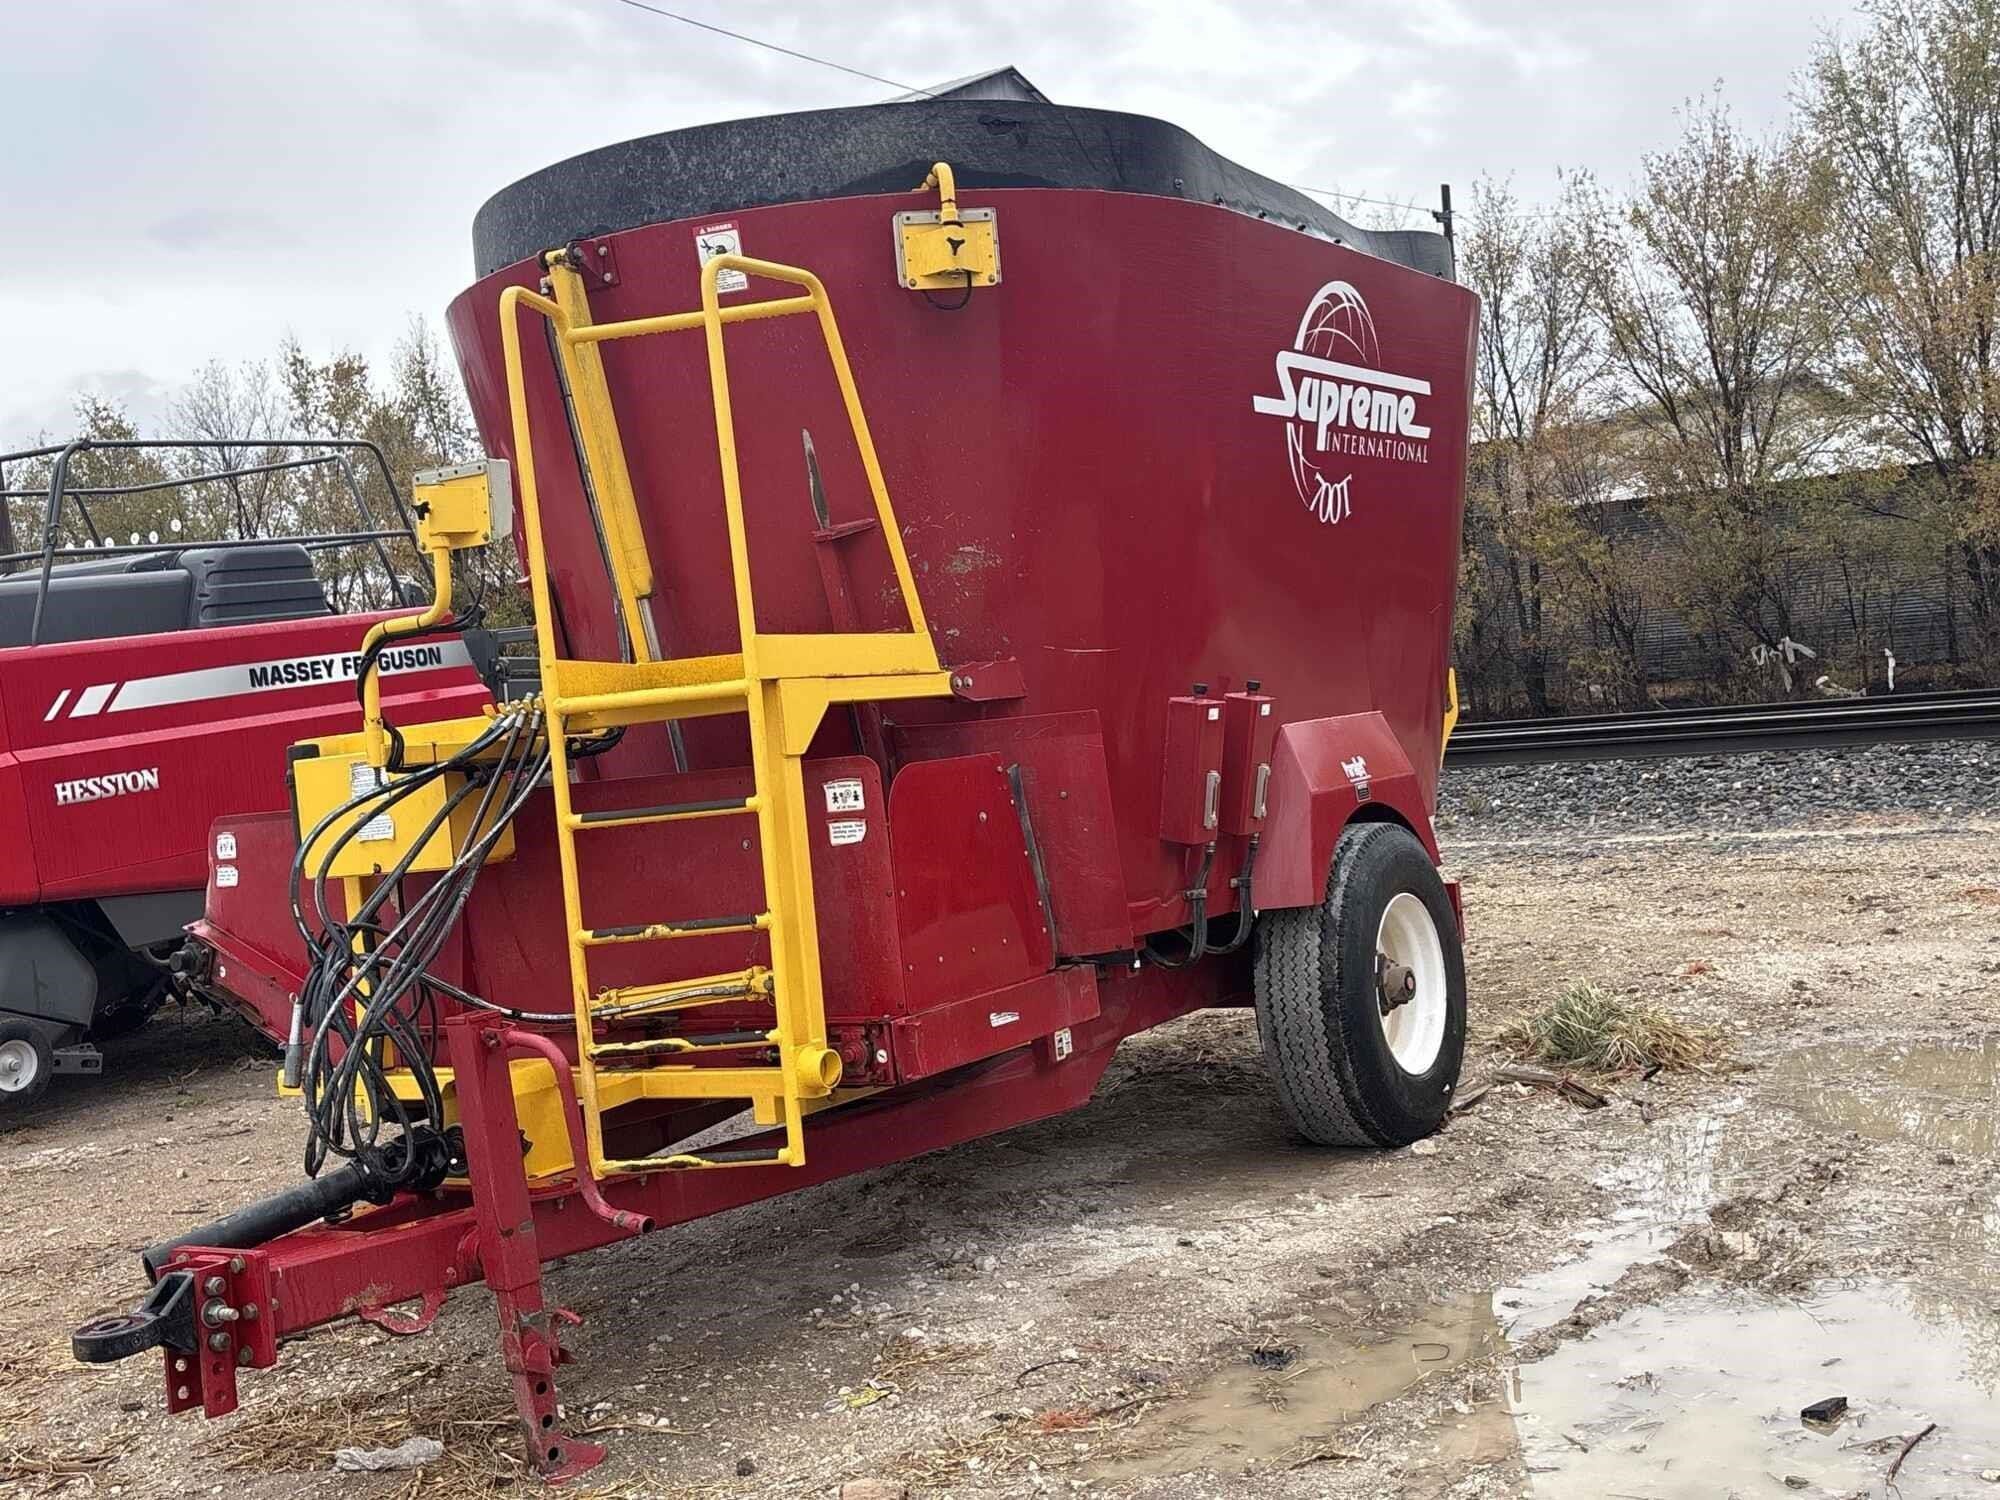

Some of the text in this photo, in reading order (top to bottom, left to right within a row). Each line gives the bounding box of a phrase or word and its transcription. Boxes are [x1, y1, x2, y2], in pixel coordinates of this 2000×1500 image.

[1253, 350, 1431, 451] Supreme
[1326, 431, 1428, 464] INTERNATIONAL
[249, 646, 442, 688] MASSEY FEGUSON
[54, 767, 159, 806] HESSTON
